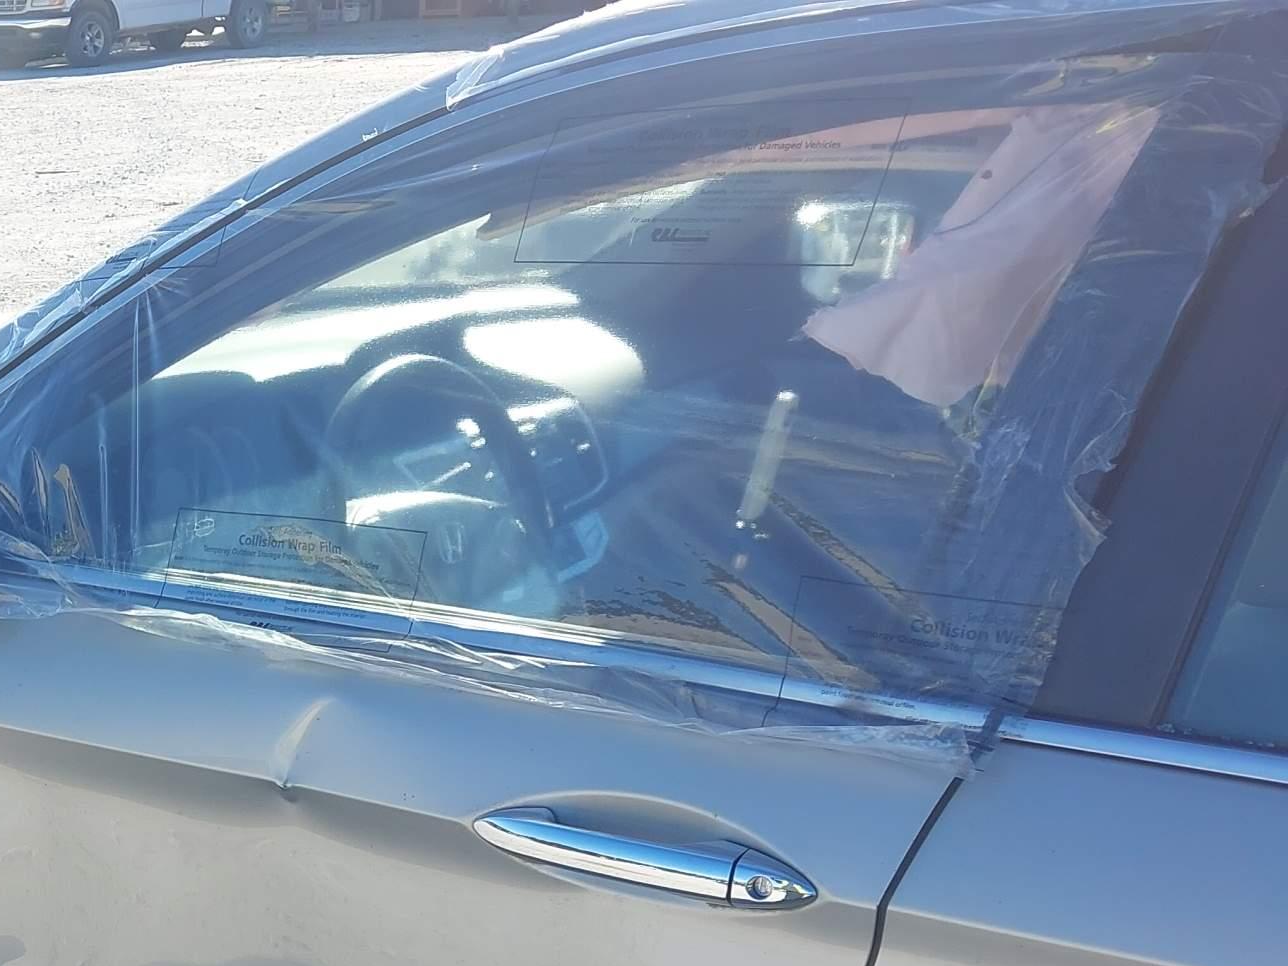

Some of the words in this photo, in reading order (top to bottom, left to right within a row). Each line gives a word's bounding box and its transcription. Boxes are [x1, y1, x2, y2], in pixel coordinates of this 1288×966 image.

[759, 139, 802, 151] Damaged
[805, 140, 841, 150] Vehicles
[239, 534, 285, 549] Collision
[287, 538, 315, 553] Wrap
[319, 541, 342, 555] Film
[911, 619, 989, 641] Collision
